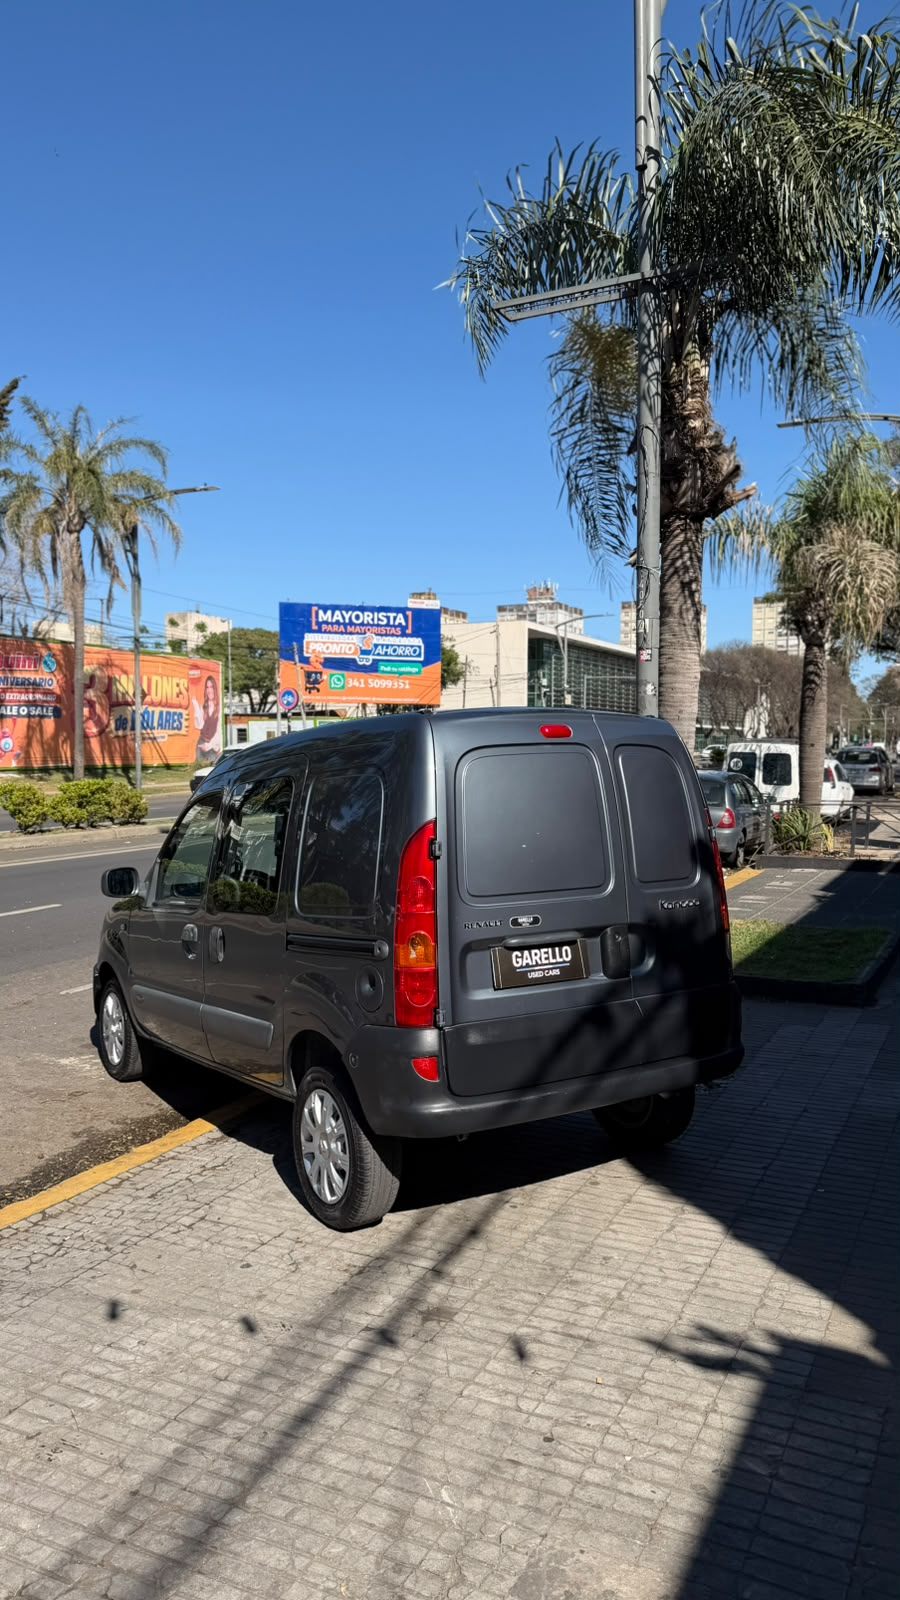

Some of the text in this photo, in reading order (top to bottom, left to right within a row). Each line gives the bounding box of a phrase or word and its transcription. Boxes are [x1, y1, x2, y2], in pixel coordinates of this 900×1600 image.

[318, 609, 406, 626] MAYORISTA
[322, 624, 401, 635] PARA MAYORISTAS
[308, 642, 420, 656] PRONTO AHORRO
[347, 678, 365, 688] 341
[29, 706, 54, 716] SALE
[114, 714, 128, 731] de
[464, 920, 502, 930] RENAULT
[512, 945, 572, 967] GARELLO
[527, 969, 561, 979] USED CARS
